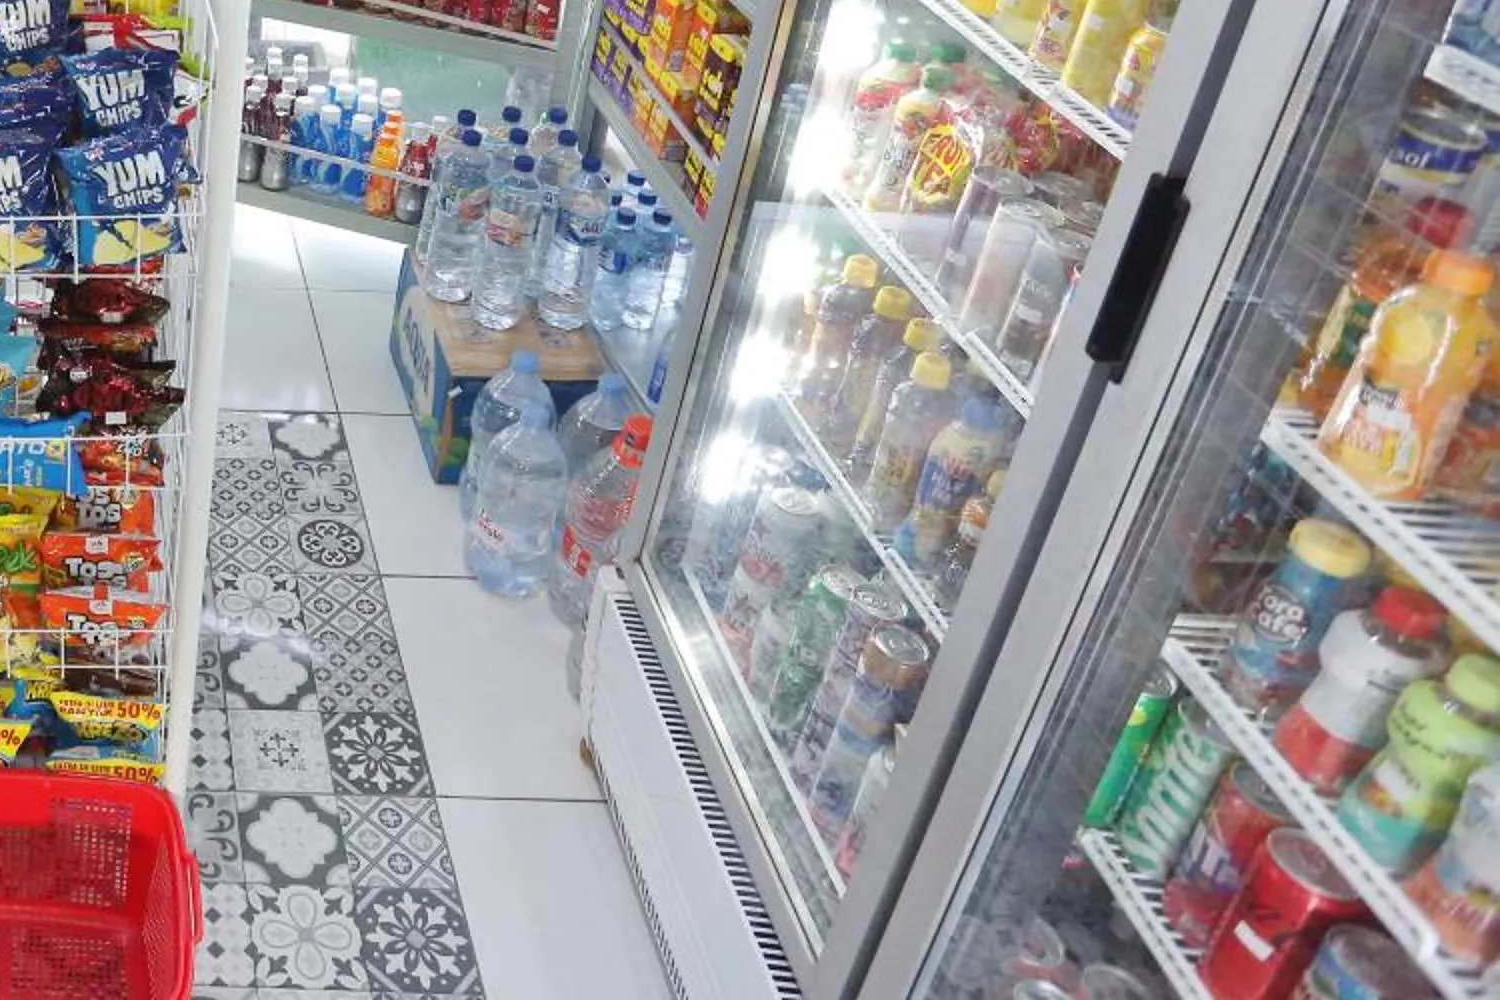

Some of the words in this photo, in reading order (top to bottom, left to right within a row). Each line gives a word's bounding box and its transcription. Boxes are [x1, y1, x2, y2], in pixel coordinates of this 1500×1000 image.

[76, 69, 146, 111] YUM
[96, 101, 142, 127] CHIPS
[94, 150, 165, 196] YUM
[113, 186, 165, 210] CHIPS
[116, 702, 162, 720] 50%
